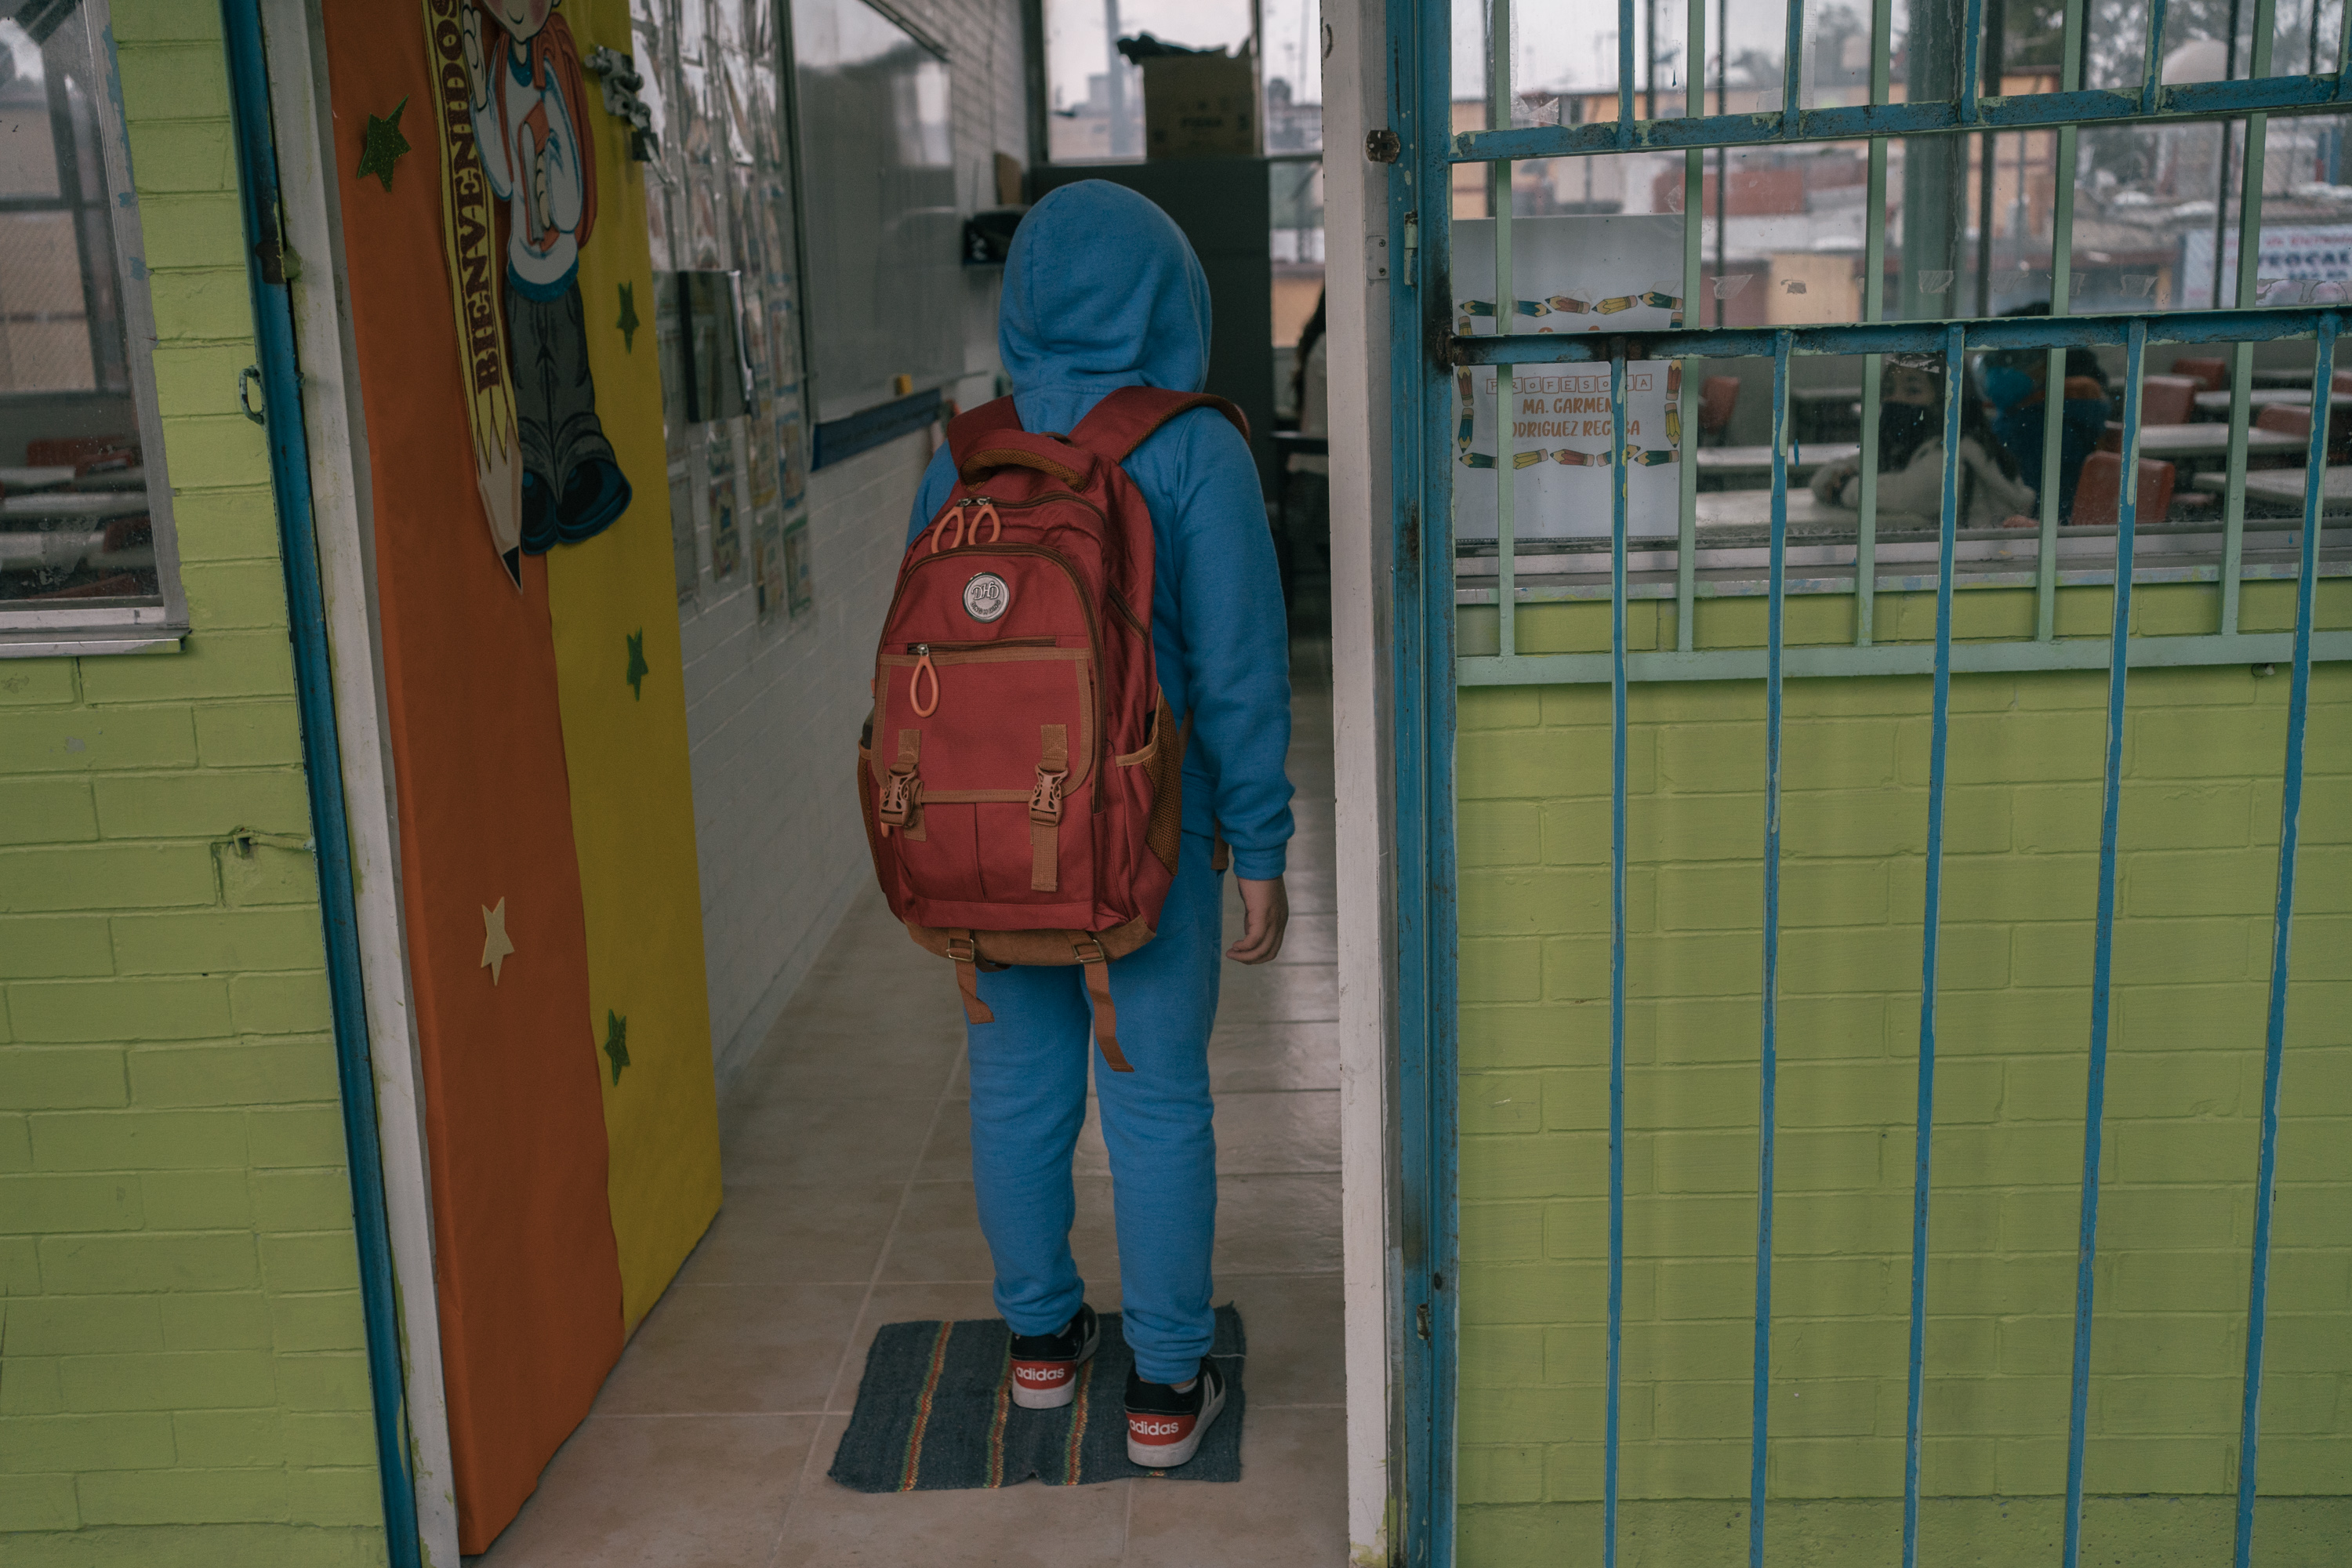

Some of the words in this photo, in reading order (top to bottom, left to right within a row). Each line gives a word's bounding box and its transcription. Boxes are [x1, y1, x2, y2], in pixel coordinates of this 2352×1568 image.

[1523, 398, 1548, 414] MA.
[1016, 1367, 1065, 1381] adidas
[1129, 1417, 1179, 1436] adidas
